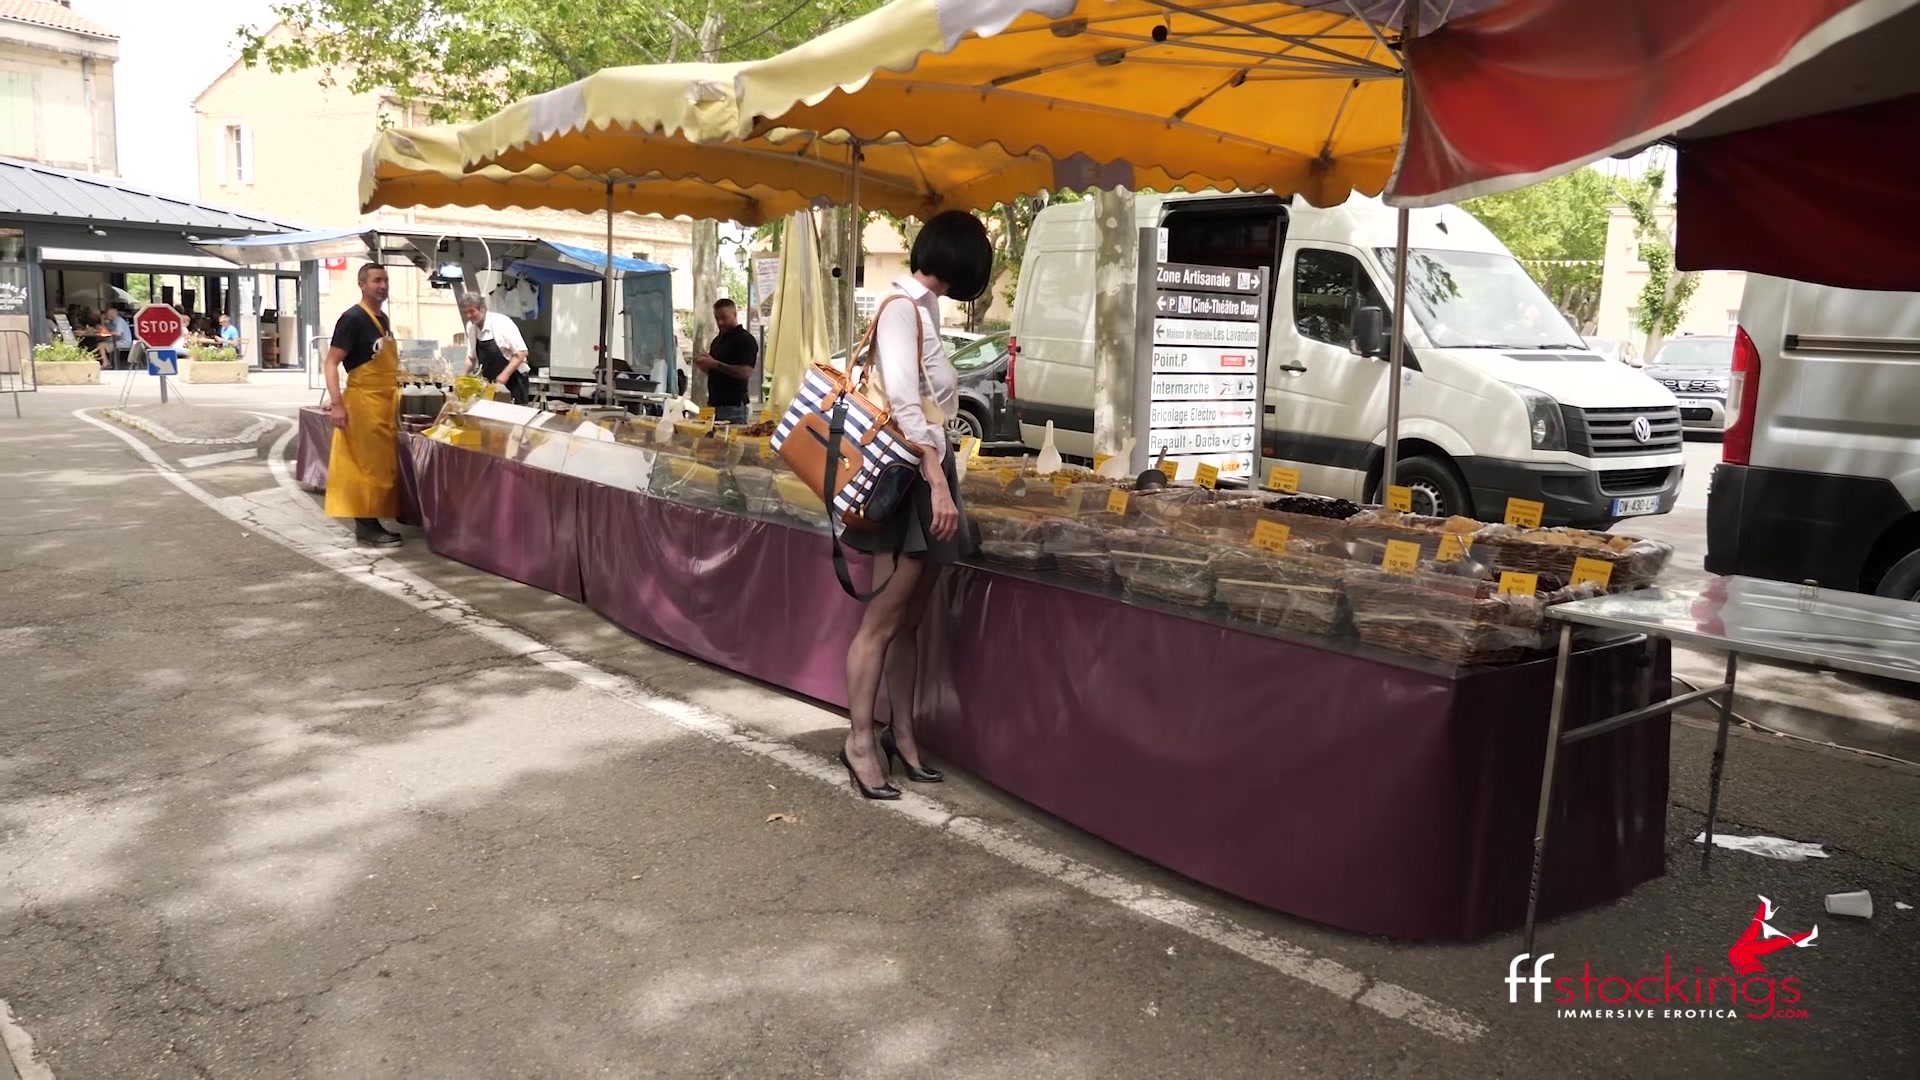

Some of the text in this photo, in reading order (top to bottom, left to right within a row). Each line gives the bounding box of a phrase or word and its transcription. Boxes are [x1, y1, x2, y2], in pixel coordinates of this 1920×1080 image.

[1157, 267, 1231, 287] Zone Artisanale
[1192, 298, 1239, 315] Ciné-Théâtre
[1240, 301, 1259, 319] Dany
[140, 320, 178, 333] STOP
[1167, 328, 1185, 339] Maison
[1193, 329, 1212, 340] Retraite
[1213, 327, 1225, 341] Les
[1226, 327, 1257, 342] Lavandins
[1154, 353, 1188, 368] Point.P
[1151, 407, 1216, 424] Bricolage Electro
[1150, 435, 1186, 449] Renault
[1195, 433, 1220, 448] Dacia
